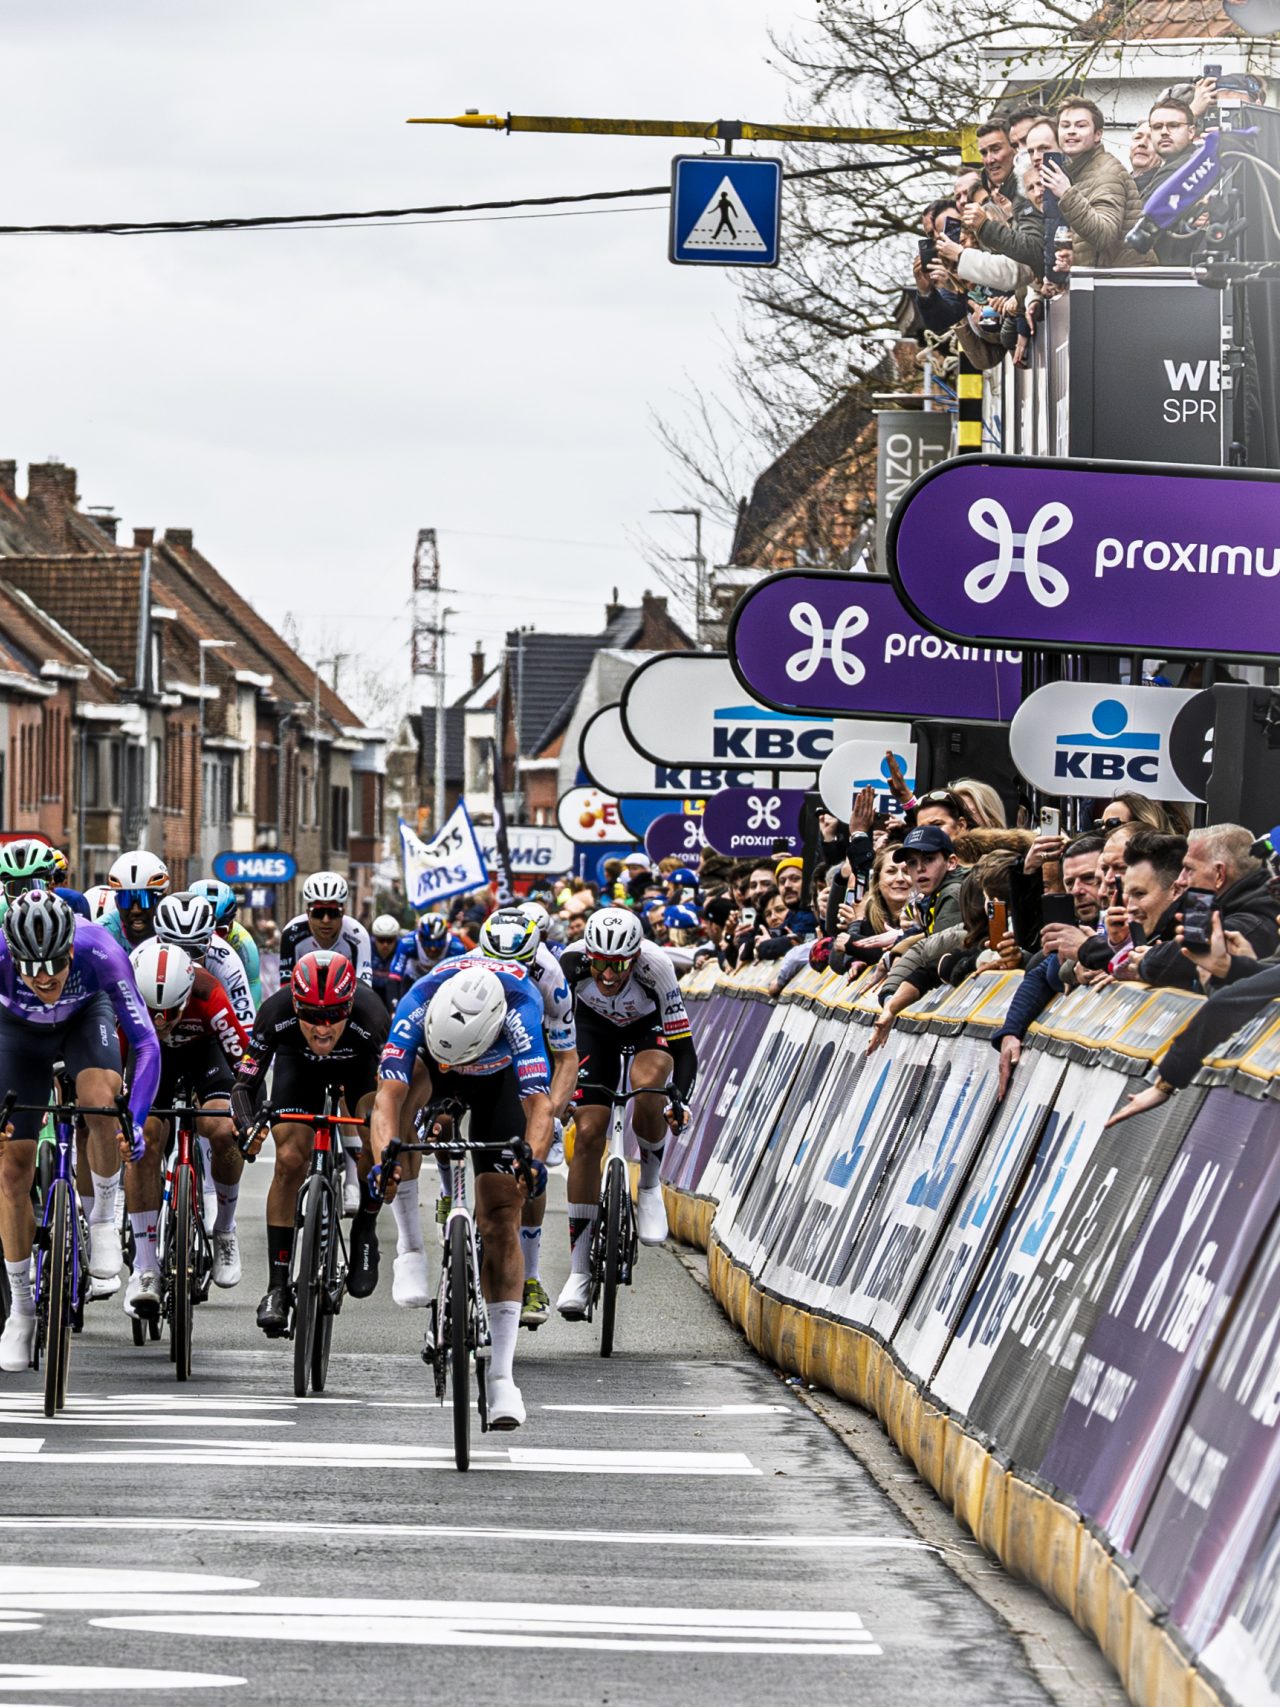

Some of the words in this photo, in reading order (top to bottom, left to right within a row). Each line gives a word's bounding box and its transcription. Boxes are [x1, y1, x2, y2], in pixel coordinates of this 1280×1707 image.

[1181, 157, 1216, 192] LYNX
[713, 727, 834, 759] KBC
[1054, 750, 1159, 783] KBC
[237, 858, 287, 877] MAES
[482, 846, 552, 866] KMG
[228, 970, 254, 1025] INEOS
